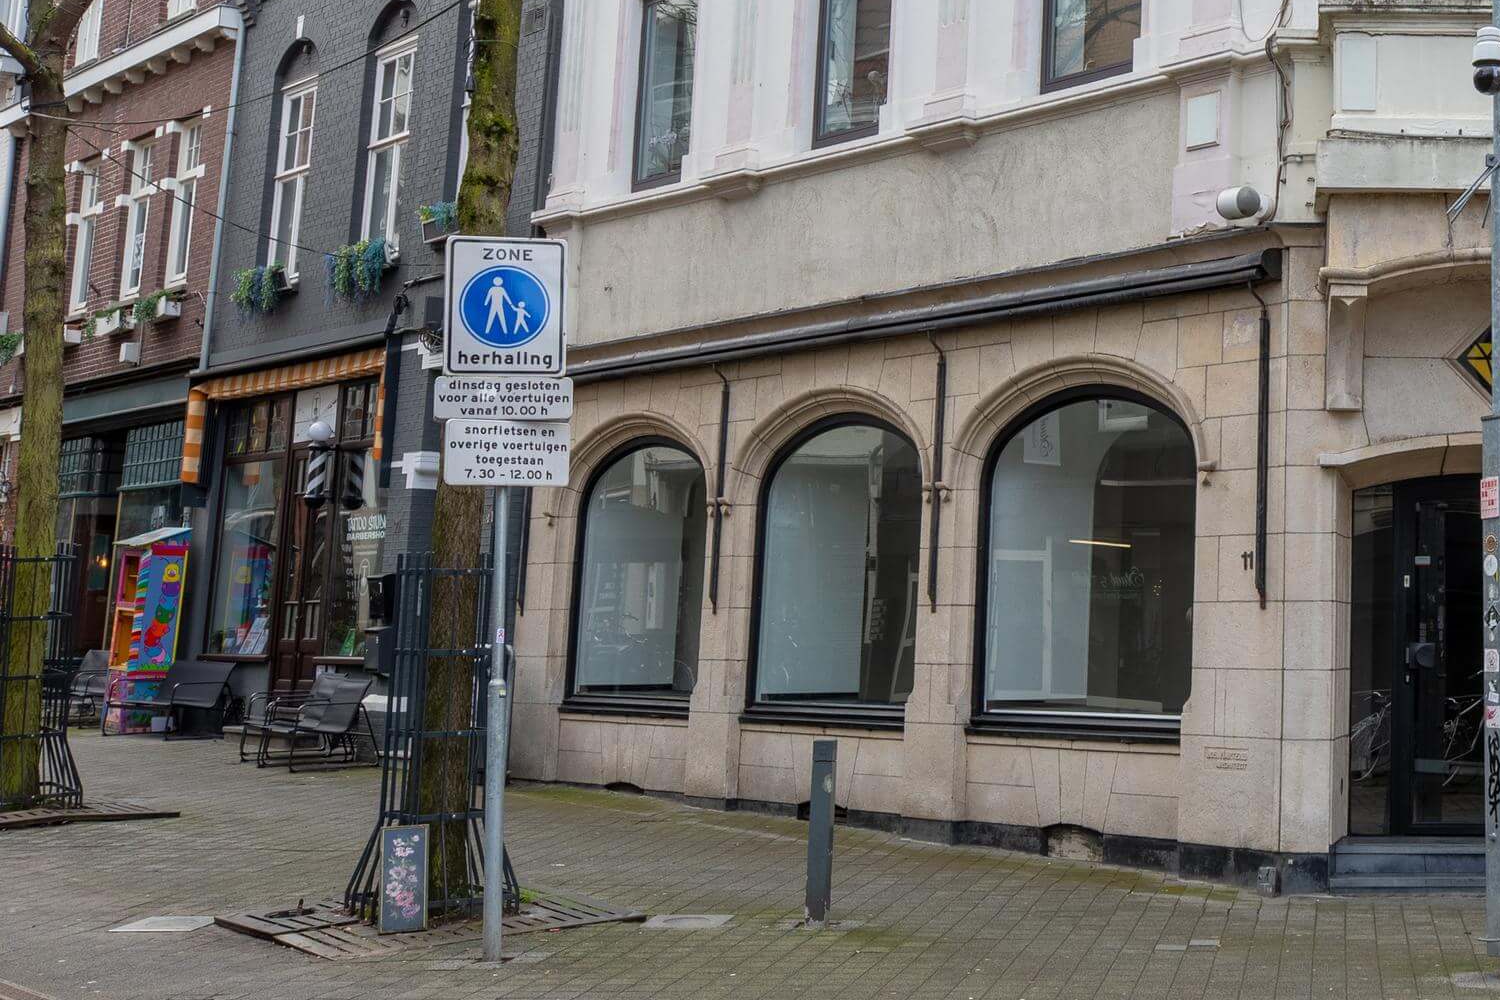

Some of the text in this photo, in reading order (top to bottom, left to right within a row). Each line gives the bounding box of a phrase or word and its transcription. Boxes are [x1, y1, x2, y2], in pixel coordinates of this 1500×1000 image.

[483, 248, 533, 261] ZONE
[457, 351, 553, 369] herhaling
[448, 380, 560, 393] dinsdag gesloten
[438, 393, 570, 405] voor alle voertuigen
[460, 405, 548, 416] vanaf 10.00 h
[464, 424, 555, 437] snorfietsen en
[450, 440, 567, 453] overige voertuigen
[475, 455, 544, 467] toegestaan
[464, 469, 496, 480] 7.30
[509, 470, 543, 480] 12.00
[545, 470, 553, 481] h
[1241, 551, 1254, 571] 11
